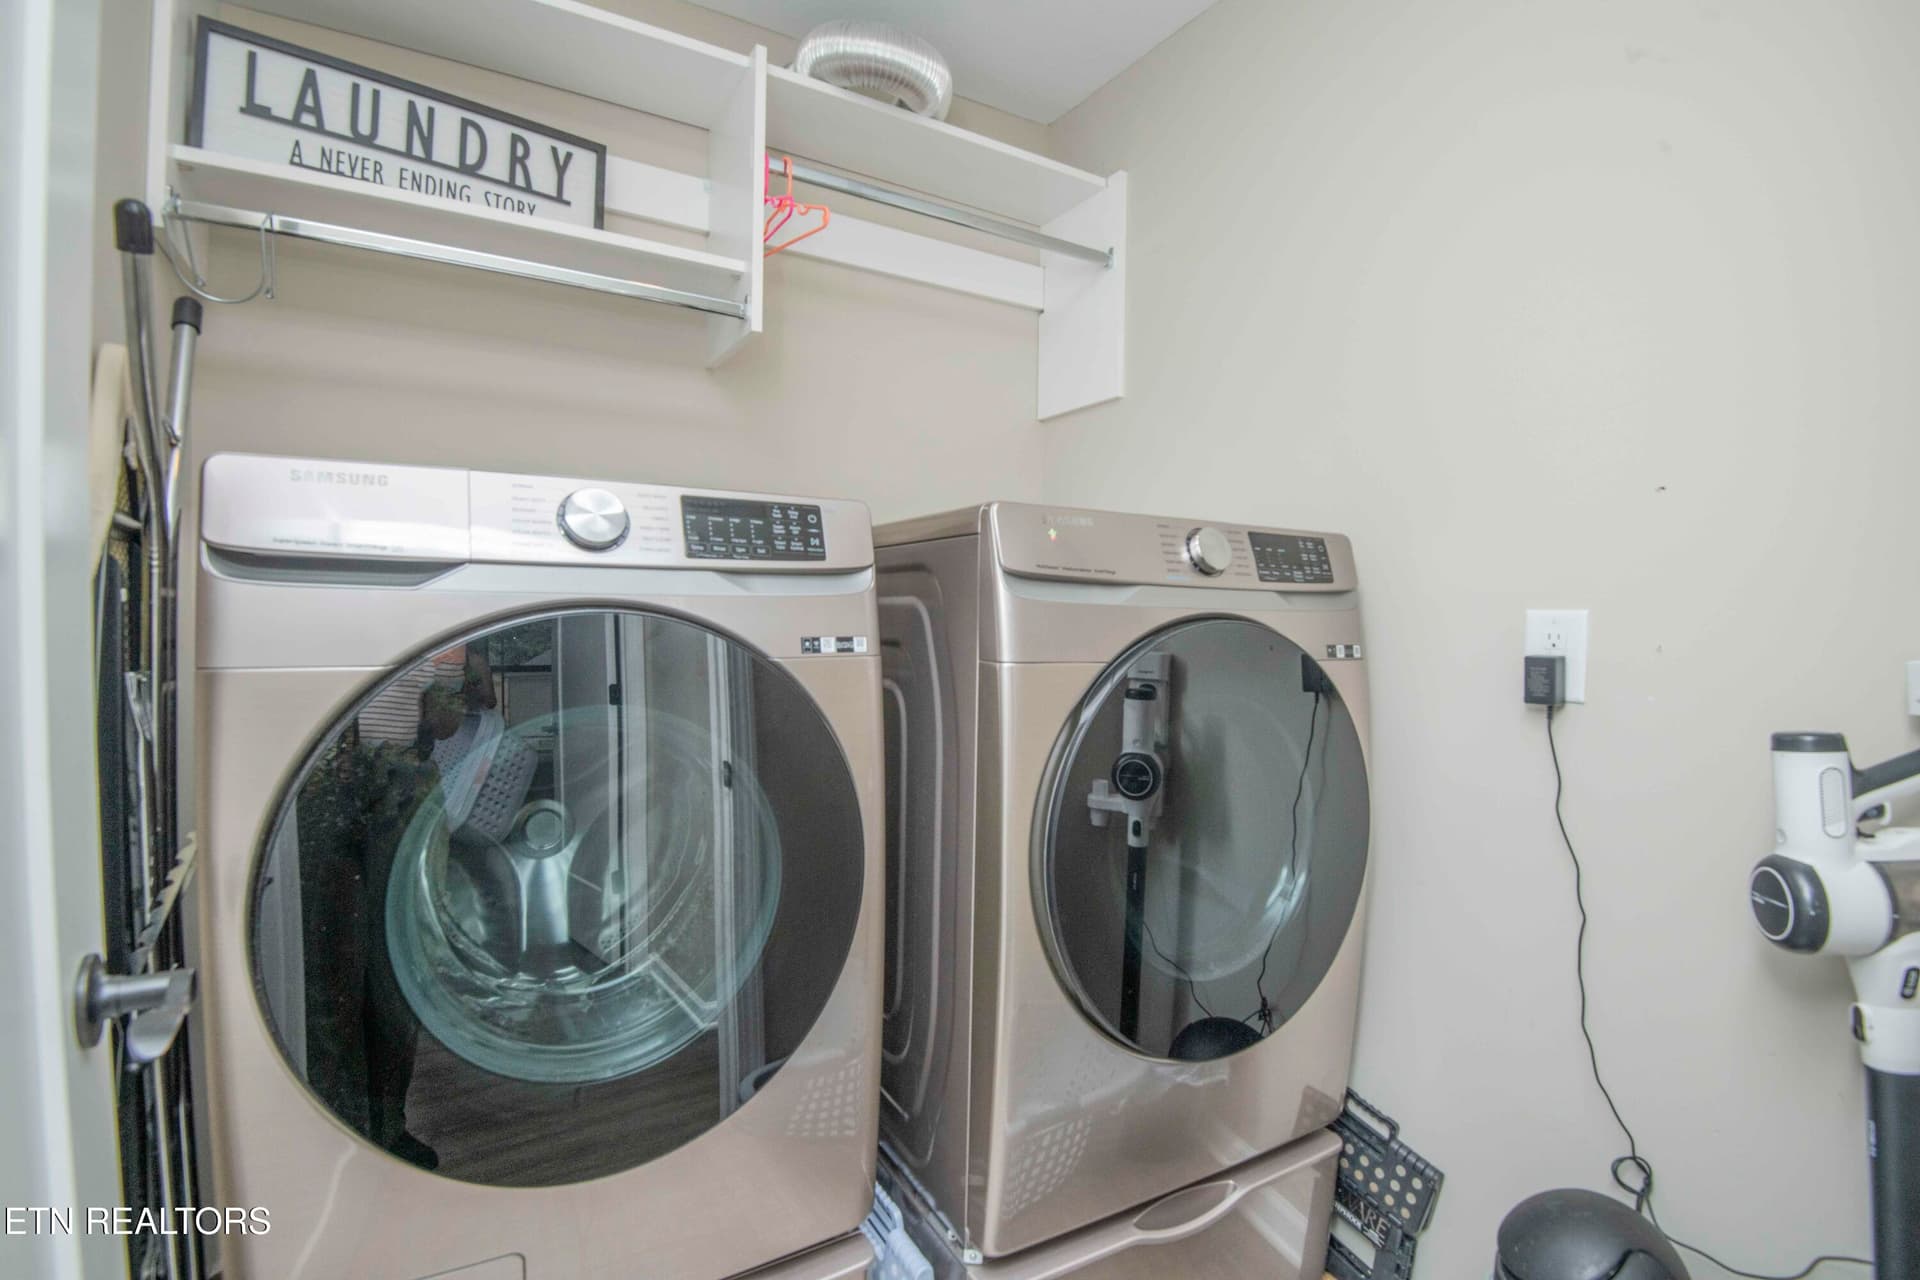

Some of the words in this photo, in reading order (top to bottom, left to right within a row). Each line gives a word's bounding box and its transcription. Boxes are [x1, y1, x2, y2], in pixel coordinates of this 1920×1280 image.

[239, 50, 573, 206] LAUNDRY
[289, 139, 304, 167] A
[320, 146, 384, 185] NEVER
[400, 167, 472, 203] ENDING
[289, 468, 390, 488] SAMSUNG
